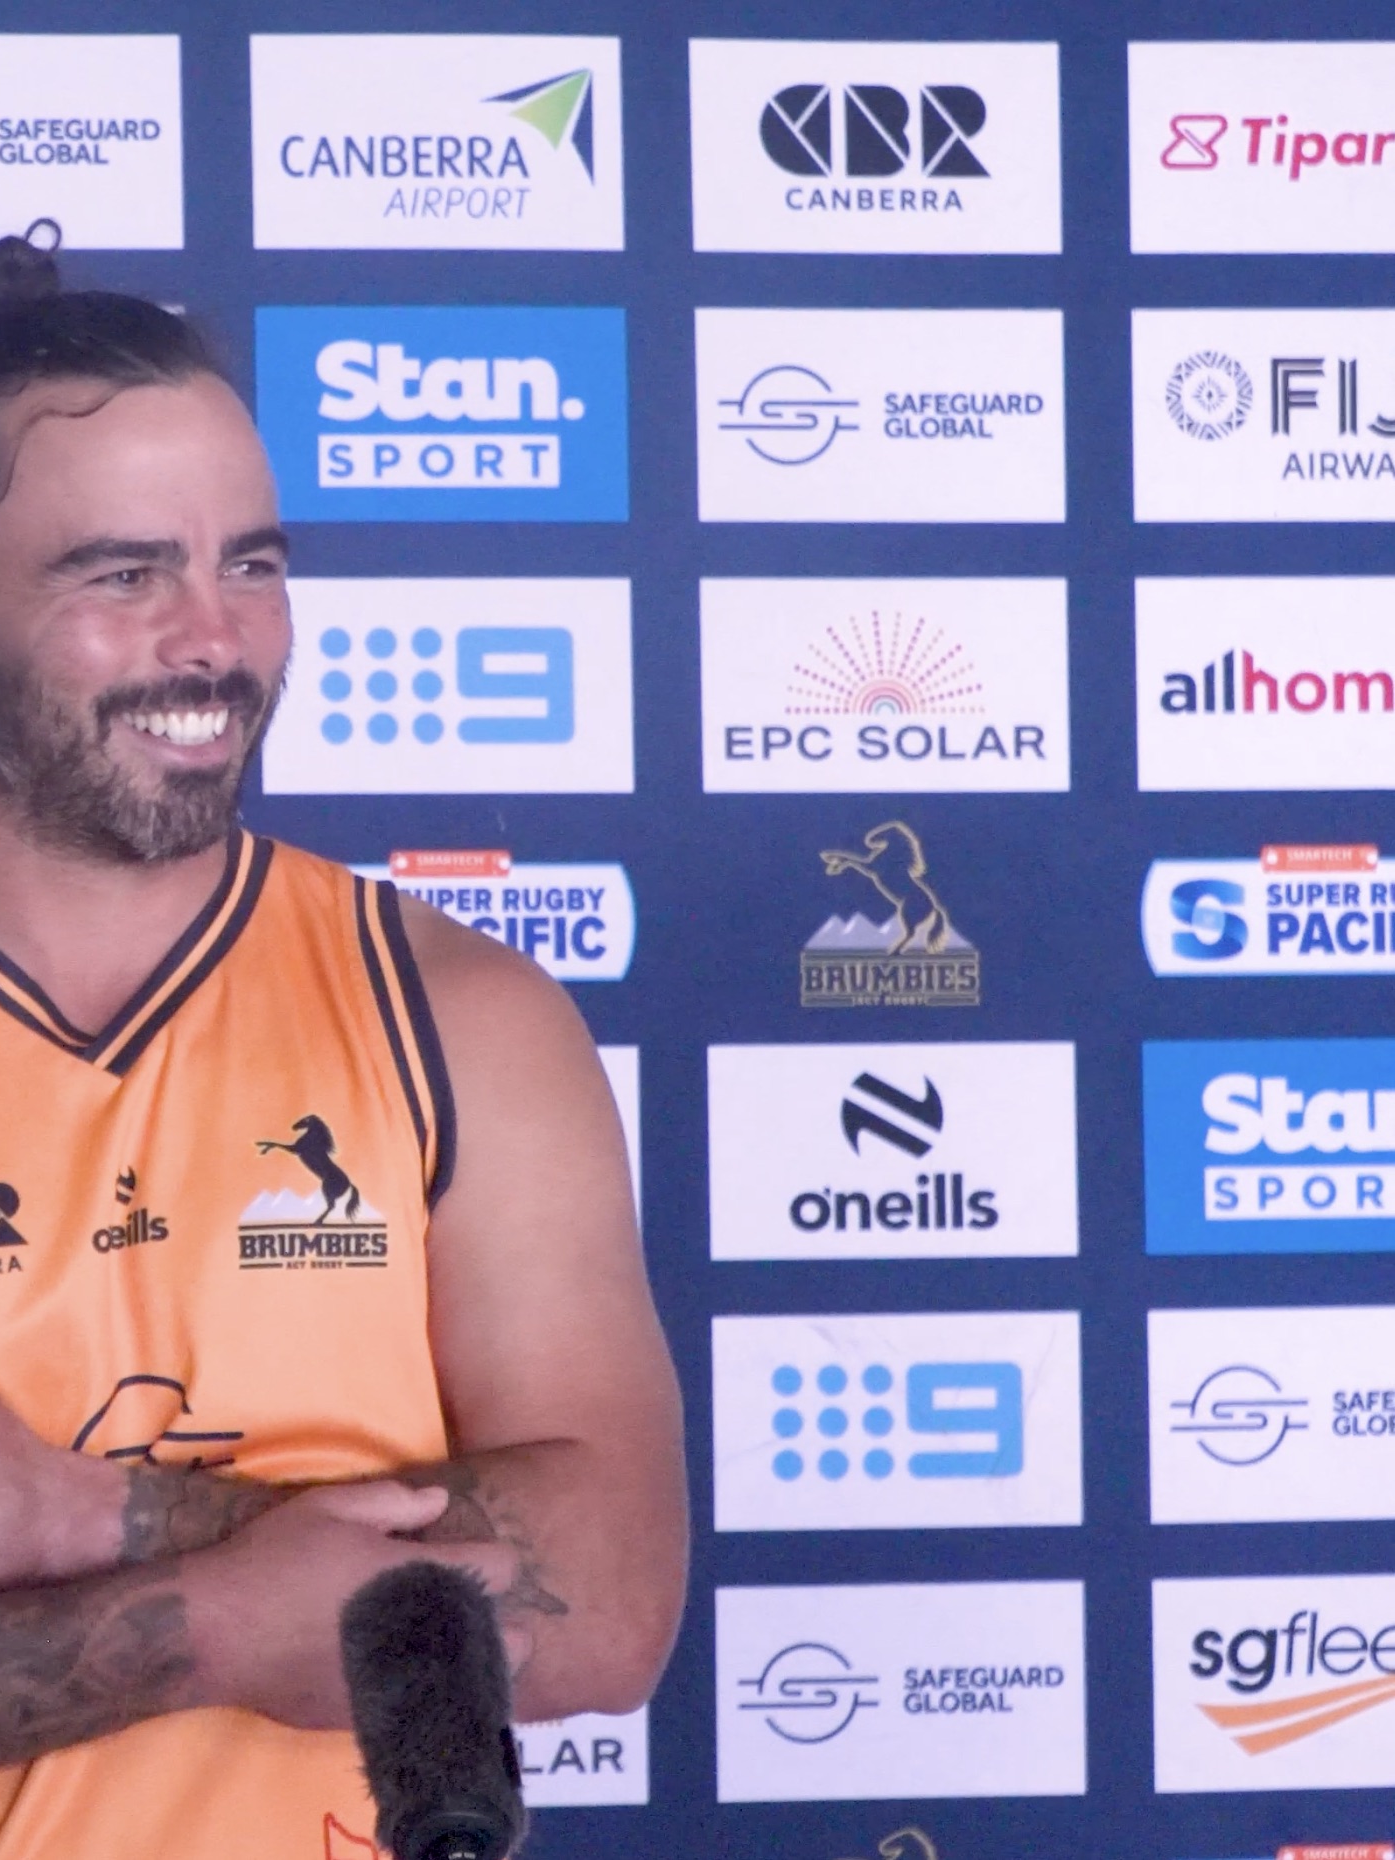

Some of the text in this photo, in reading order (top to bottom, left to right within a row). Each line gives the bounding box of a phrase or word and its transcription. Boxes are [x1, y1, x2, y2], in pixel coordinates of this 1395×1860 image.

[281, 136, 529, 178] CANBERRA
[384, 187, 531, 219] AIRPORT
[785, 188, 962, 211] CANBERRA
[316, 339, 585, 421] Stan.
[885, 393, 1043, 416] SAFEGUARD
[884, 416, 992, 438] GLOBAL
[328, 443, 549, 478] SPORT
[1160, 650, 1393, 714] allhom
[725, 726, 1044, 760] EPC SOLAR
[502, 888, 605, 912] RUGBY
[1267, 883, 1360, 907] SUPER
[1267, 911, 1395, 955] PACI
[805, 964, 978, 992] BRUMBIES
[1214, 1175, 1384, 1210] SPOR
[239, 1232, 388, 1259] BRUMBIES
[904, 1666, 1064, 1690] SAFEGUARD
[904, 1691, 1013, 1714] GLOBAL
[517, 1737, 625, 1774] LAR
